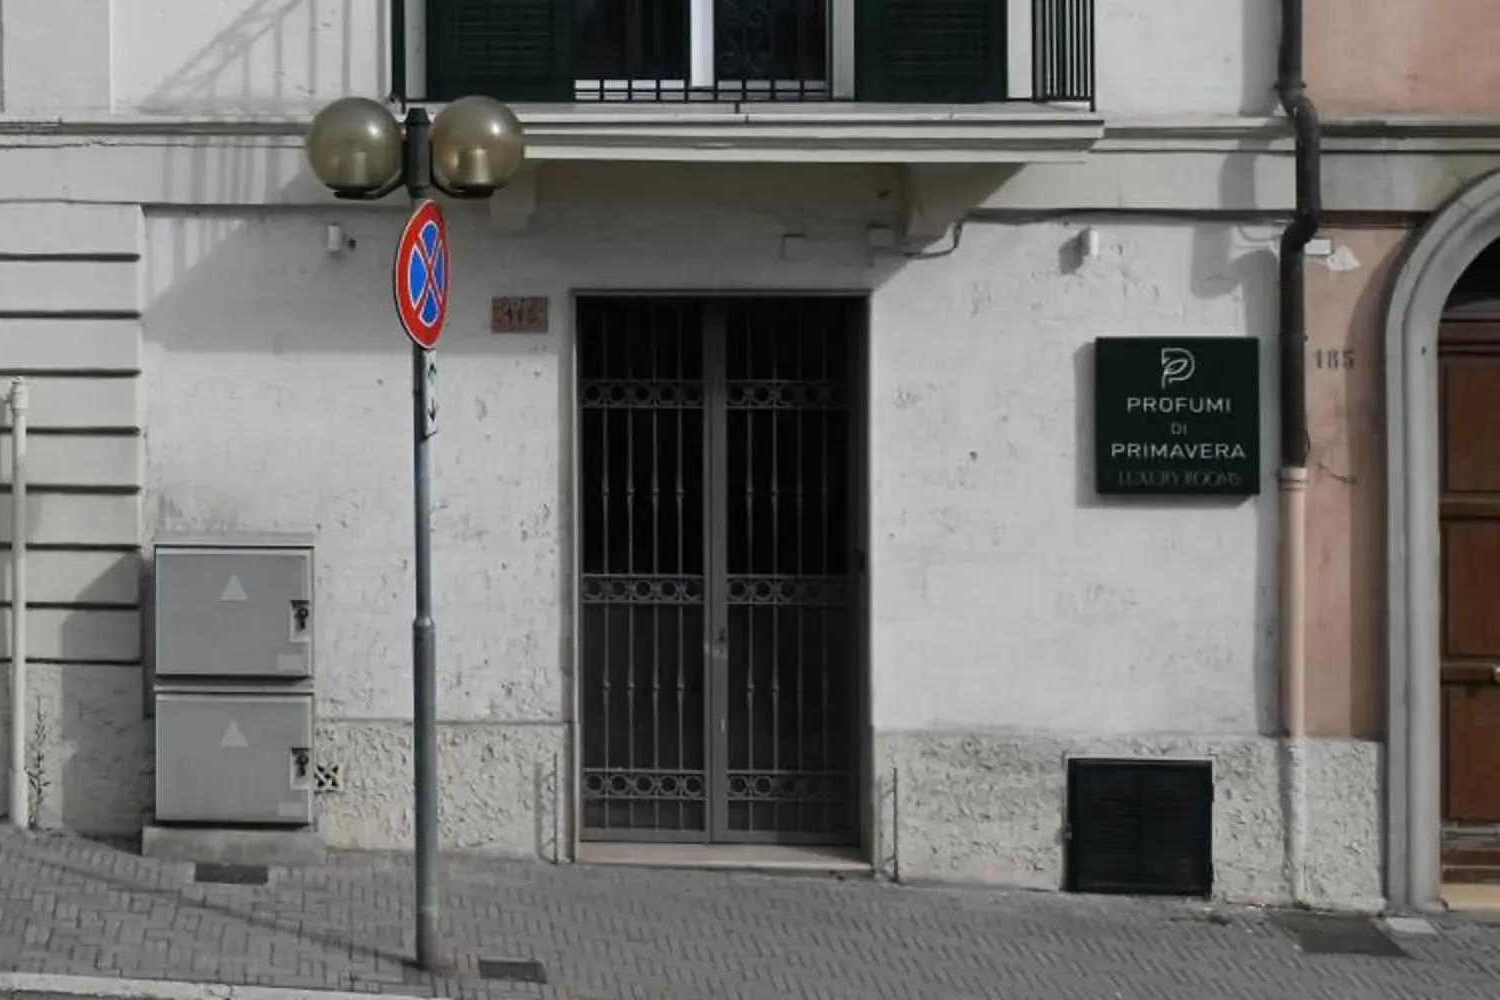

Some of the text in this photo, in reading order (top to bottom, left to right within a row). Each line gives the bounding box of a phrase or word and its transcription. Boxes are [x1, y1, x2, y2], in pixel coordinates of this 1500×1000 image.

[1127, 397, 1231, 413] PROFUMI
[1171, 422, 1187, 435] DI
[1111, 443, 1246, 460] PRIMAVERA
